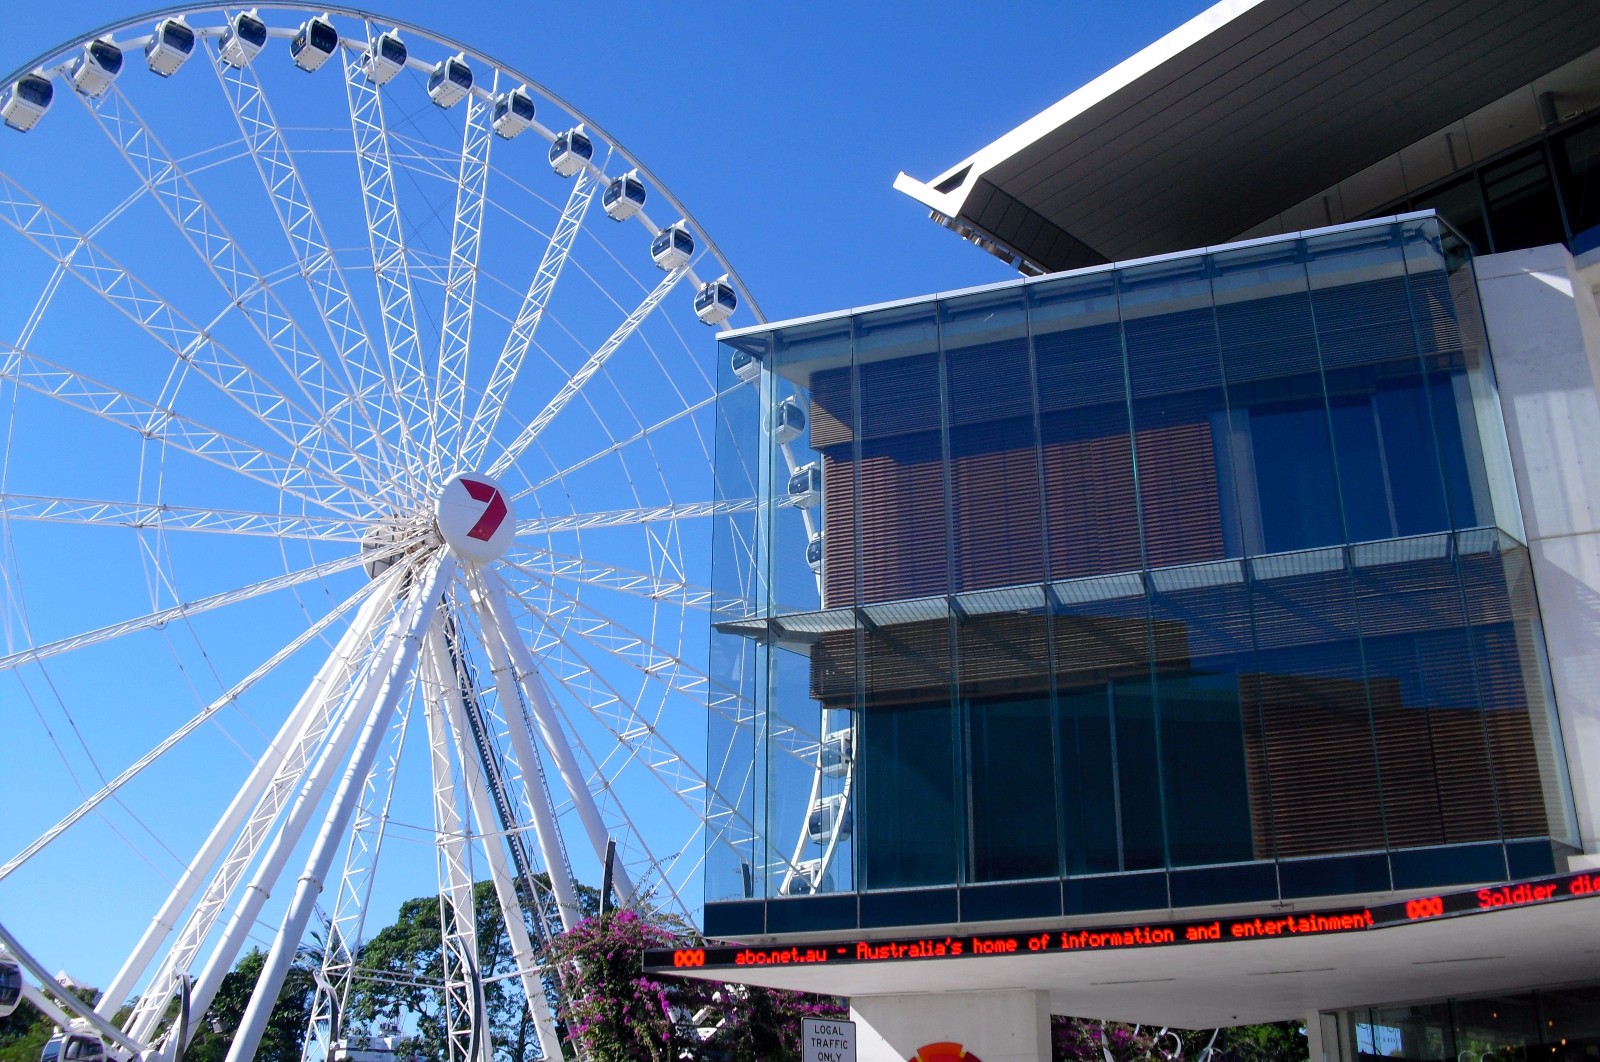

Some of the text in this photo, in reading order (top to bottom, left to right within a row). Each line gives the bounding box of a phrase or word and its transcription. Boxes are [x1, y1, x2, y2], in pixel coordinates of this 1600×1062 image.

[1476, 883, 1558, 909] Soldier
[734, 947, 828, 967] abc.net.au
[855, 936, 963, 961] Australia's
[972, 936, 1018, 954] home
[1028, 933, 1050, 952] of
[1060, 926, 1175, 950] information
[1185, 921, 1221, 942] and
[1231, 909, 1375, 939] entertainment
[810, 1037, 848, 1050] TRAFFIC
[817, 1051, 842, 1062] ONLY
